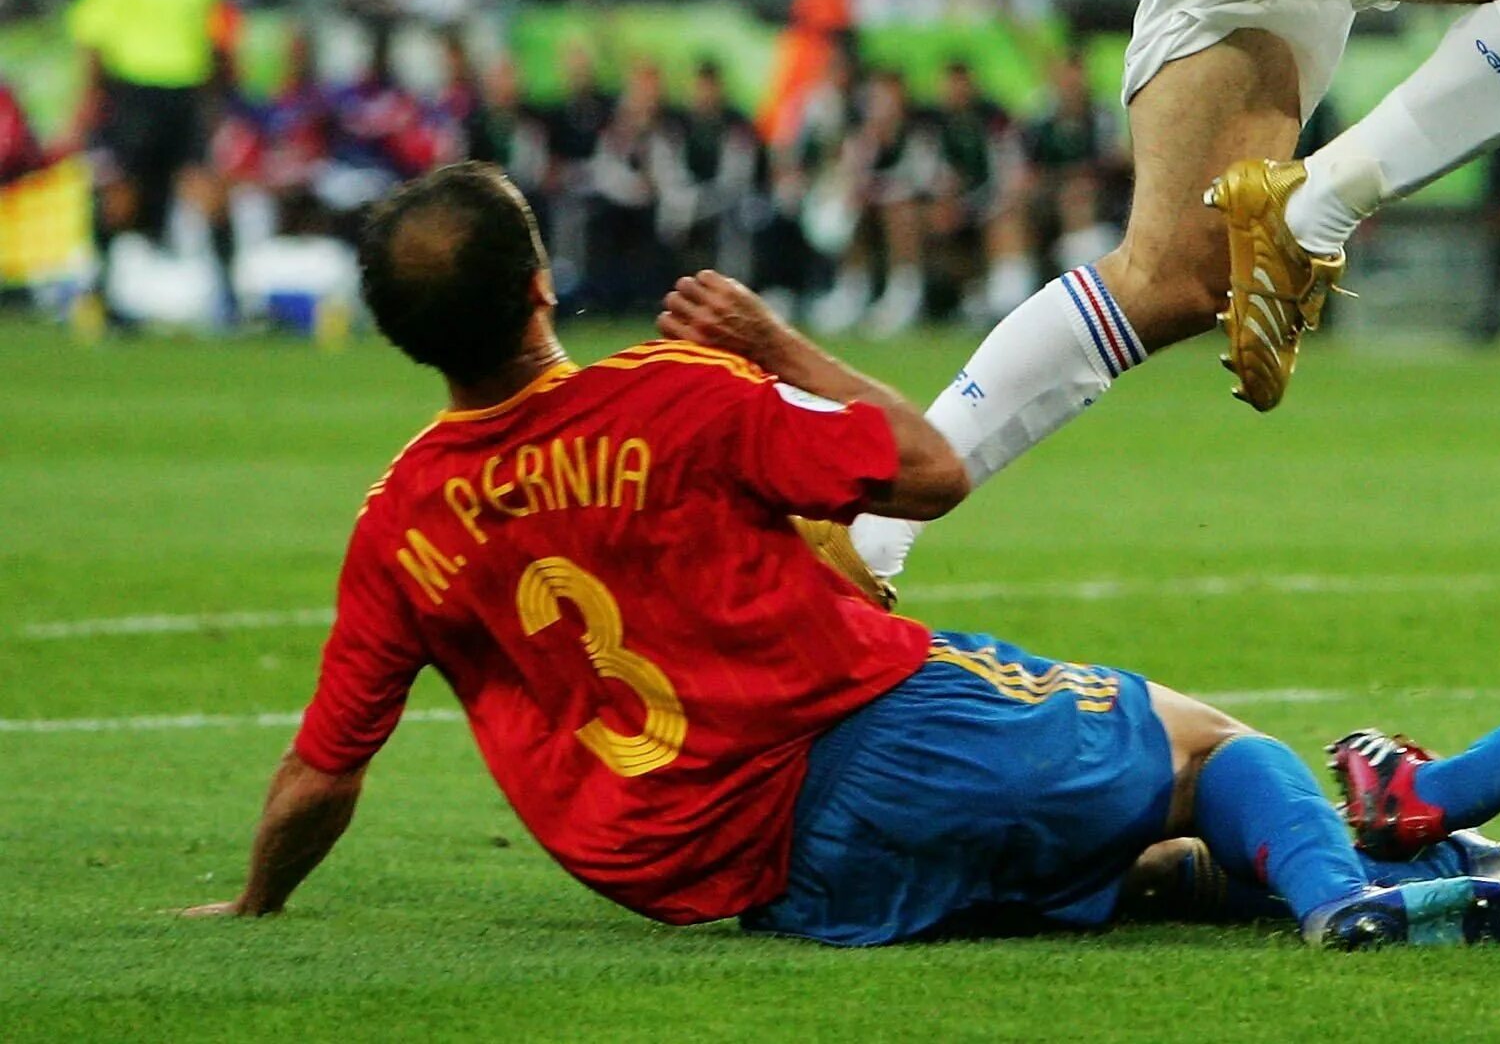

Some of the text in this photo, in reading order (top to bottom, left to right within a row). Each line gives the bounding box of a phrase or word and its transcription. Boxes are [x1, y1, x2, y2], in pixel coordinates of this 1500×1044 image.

[396, 435, 652, 606] M. PERNIA
[516, 556, 688, 778] 3
